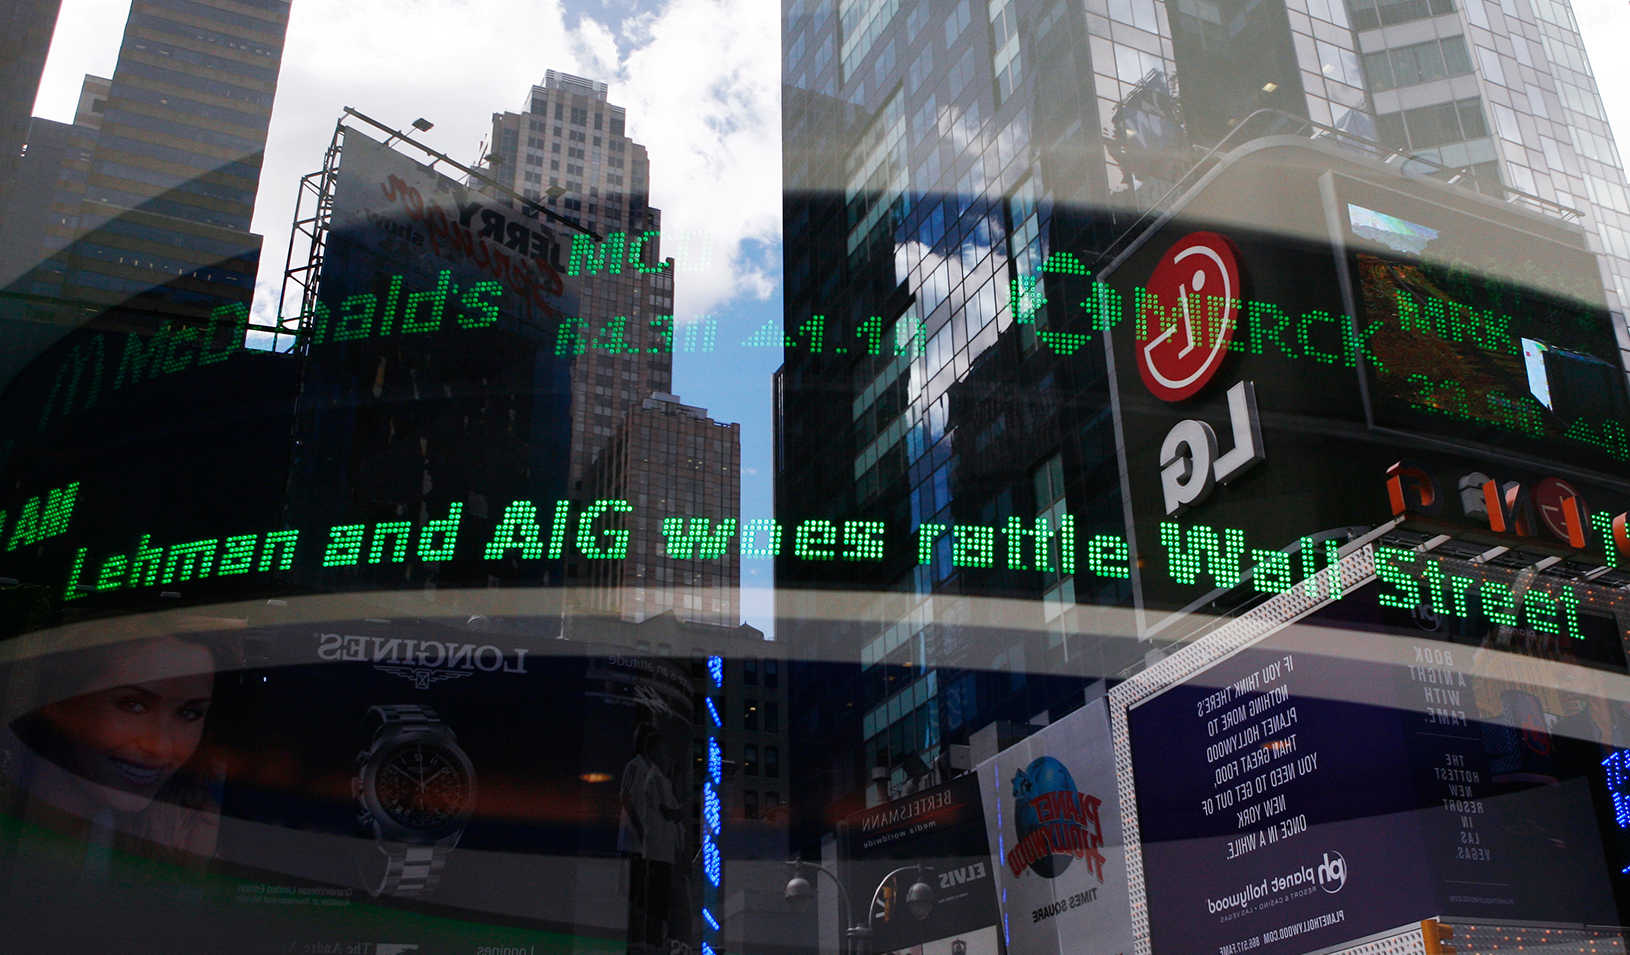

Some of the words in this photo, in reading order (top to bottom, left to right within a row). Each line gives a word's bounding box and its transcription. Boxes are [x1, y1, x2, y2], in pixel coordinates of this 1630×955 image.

[567, 230, 714, 276] MCD
[1134, 286, 1389, 373] MERCK
[1396, 290, 1518, 356] MRK
[63, 529, 300, 601] Lehman
[322, 502, 464, 568] and
[483, 499, 634, 561] AIG
[662, 517, 886, 562] woes
[918, 513, 1130, 579] rattle
[1159, 521, 1343, 601] Wall
[1373, 545, 1586, 640] Street
